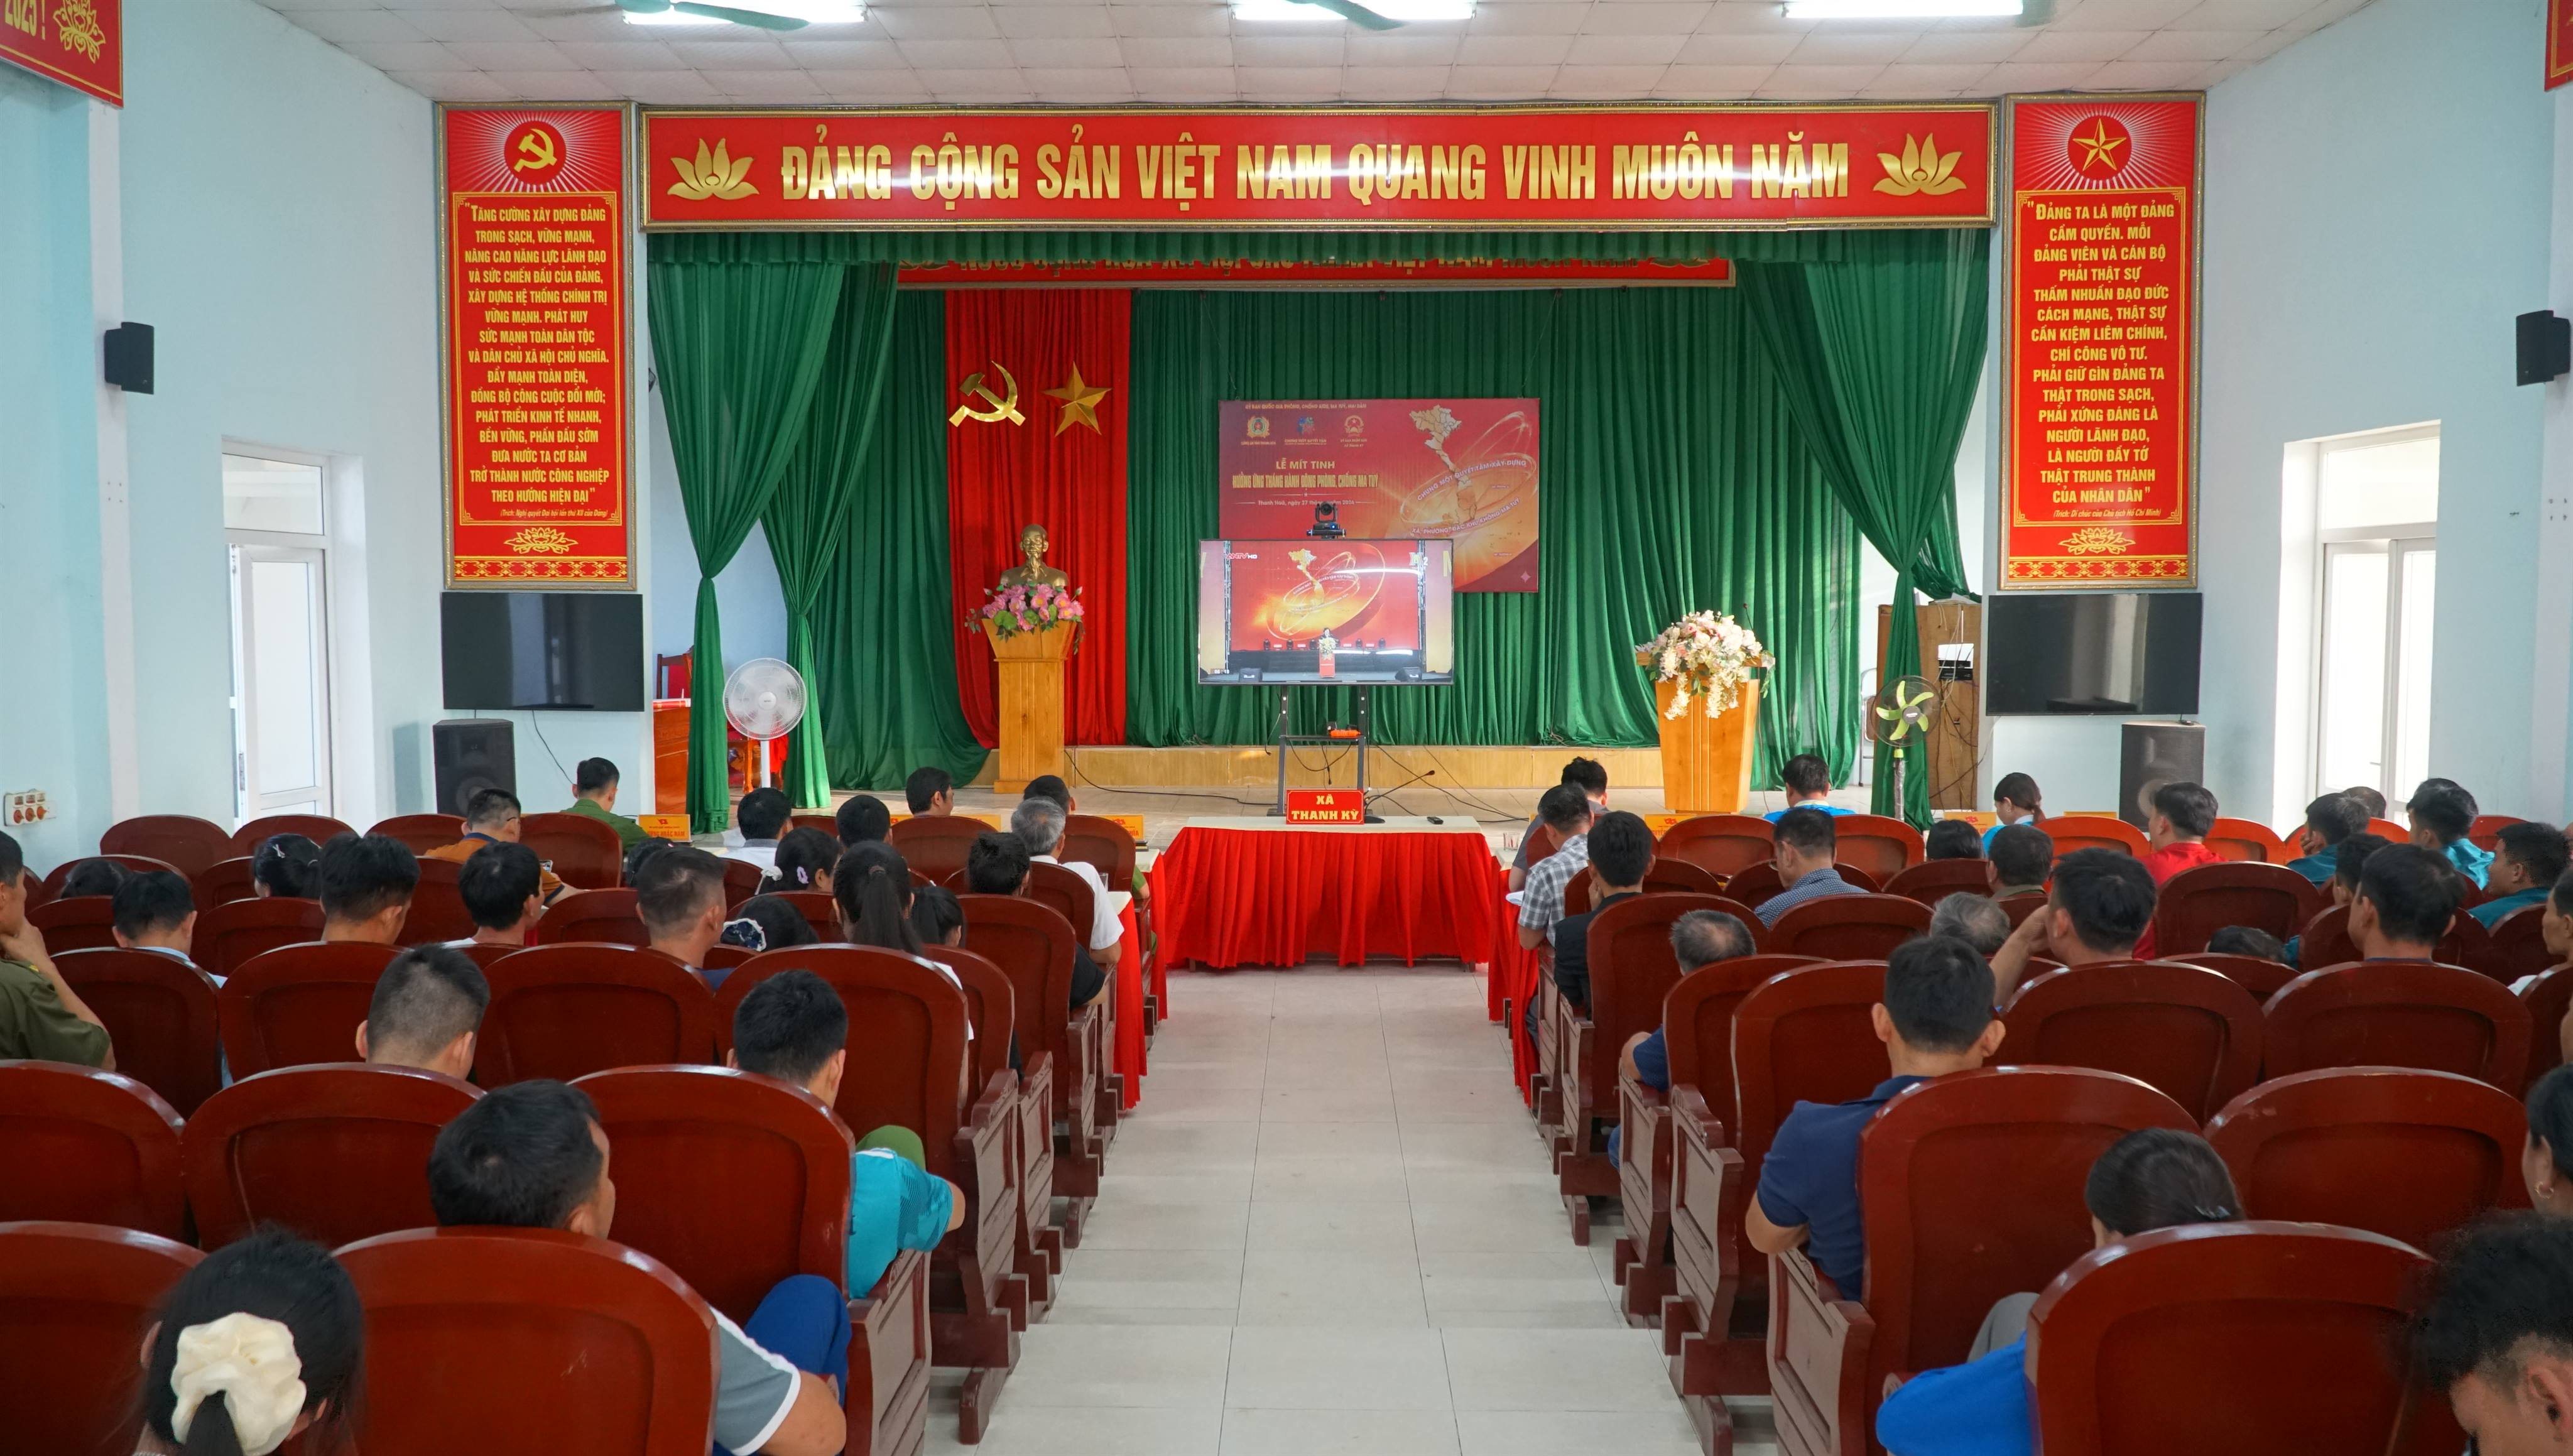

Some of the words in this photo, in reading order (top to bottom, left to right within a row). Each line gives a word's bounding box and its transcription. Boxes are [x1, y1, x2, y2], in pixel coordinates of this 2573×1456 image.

[781, 124, 892, 200] ĐẢNG
[911, 132, 1018, 211] CỘNG
[1036, 124, 1121, 200] SẢN
[1136, 132, 1220, 211] VIỆT
[1237, 144, 1330, 200] NAM
[1348, 143, 1486, 206] QUANG
[1503, 145, 1596, 200] VINH
[1612, 131, 1733, 200] MUÔN
[1750, 131, 1849, 199] NĂM
[499, 207, 530, 221] CƯỜNG
[533, 207, 550, 221] XÂY
[553, 209, 578, 224] DỰNG
[580, 204, 605, 221] ĐẢNG
[2075, 207, 2089, 219] TA
[2094, 204, 2108, 219] LÀ
[2112, 203, 2137, 220] MỘT
[2141, 200, 2173, 217] ĐẢNG
[476, 231, 505, 242] TRONG
[508, 231, 535, 245] SẠCH,
[538, 228, 562, 242] VỮNG
[565, 231, 594, 245] MẠNH,
[465, 248, 490, 263] NÂNG
[493, 251, 511, 263] CAO
[514, 247, 539, 263] NĂNG
[542, 250, 558, 265] LỰC
[562, 247, 585, 263] LÃNH
[588, 251, 606, 265] ĐẠO
[2034, 244, 2067, 261] ĐẢNG
[2071, 246, 2098, 262] VIÊN
[2102, 246, 2117, 260] VÀ
[2121, 245, 2146, 260] CÁN
[2150, 244, 2165, 261] BỘ
[2060, 264, 2087, 281] PHẢI
[2091, 266, 2120, 283] THẬT
[2124, 267, 2141, 282] SỰ
[469, 288, 486, 303] XÂY
[489, 290, 513, 305] DỰNG
[516, 288, 527, 305] HỆ
[530, 287, 559, 303] THỐNG
[563, 288, 590, 303] CHÍNH
[593, 291, 607, 305] TRỊ
[2117, 287, 2141, 302] ĐẠO
[2145, 284, 2168, 299] ĐỨC
[486, 308, 509, 323] VỮNG
[512, 310, 541, 325] MẠNH.
[545, 309, 567, 323] PHÁT
[570, 311, 587, 323] HUY
[2038, 307, 2069, 321] CÁCH
[2074, 308, 2113, 322] MẠNG,
[2116, 304, 2145, 322] THẬT
[2150, 306, 2167, 321] SỰ
[480, 328, 497, 342] SỨC
[501, 330, 527, 345] MẠNH
[530, 329, 553, 343] TOÀN
[557, 329, 575, 342] DÂN
[577, 329, 594, 345] TỘC
[2060, 326, 2090, 343] KIỆM
[2094, 325, 2123, 340] LIÊM
[2127, 324, 2167, 341] CHÍNH,
[2050, 347, 2070, 361] CHÍ
[2074, 345, 2106, 361] CÔNG
[2111, 345, 2126, 361] VÔ
[2130, 347, 2147, 360] TƯ.
[508, 371, 535, 385] MẠNH
[538, 367, 561, 383] TOÀN
[564, 369, 587, 385] DIỆN,
[2033, 364, 2061, 382] PHẢI
[2065, 366, 2086, 381] GIỮ
[2089, 366, 2109, 381] GÌN
[2113, 363, 2146, 381] ĐẢNG
[2150, 367, 2164, 379] TA
[2043, 387, 2072, 405] THẬT
[2075, 389, 2114, 401] TRONG
[2119, 388, 2154, 403] SẠCH,
[476, 408, 499, 422] PHÁT
[530, 411, 552, 423] KINH
[555, 406, 564, 423] TẾ
[567, 411, 601, 425] NHANH,
[2039, 405, 2067, 422] PHẢI
[2070, 406, 2103, 421] XỨNG
[2107, 406, 2140, 421] ĐÁNG
[2144, 406, 2158, 420] LÀ
[2047, 427, 2083, 442] NGƯỜI
[2087, 427, 2118, 442] LÃNH
[2122, 429, 2149, 443] ĐẠO,
[492, 450, 510, 462] ĐƯA
[513, 447, 537, 462] NƯỚC
[540, 450, 551, 462] TA
[553, 450, 566, 462] CƠ
[568, 445, 587, 462] BẢN
[2048, 448, 2062, 462] LÀ
[2066, 447, 2102, 462] NGƯỜI
[2133, 446, 2148, 461] TỚ
[1290, 459, 1307, 469] MÍT
[1310, 461, 1335, 469] TINH
[471, 465, 487, 482] TRỞ
[489, 468, 519, 482] THÀNH
[522, 467, 546, 482] NƯỚC
[549, 468, 574, 482] CÔNG
[577, 468, 609, 484] NGHIỆP
[2040, 468, 2070, 486] THẬT
[2073, 470, 2112, 482] TRUNG
[2116, 467, 2155, 482] THÀNH
[492, 490, 513, 502] THEO
[516, 487, 547, 502] HƯỚNG
[550, 488, 570, 504] HIỆN
[2053, 486, 2077, 503] CỦA
[2081, 488, 2114, 503] NHÂN
[1316, 794, 1334, 805] XÃ
[1292, 810, 1338, 820] THANH
[1341, 809, 1359, 820] KỲ
